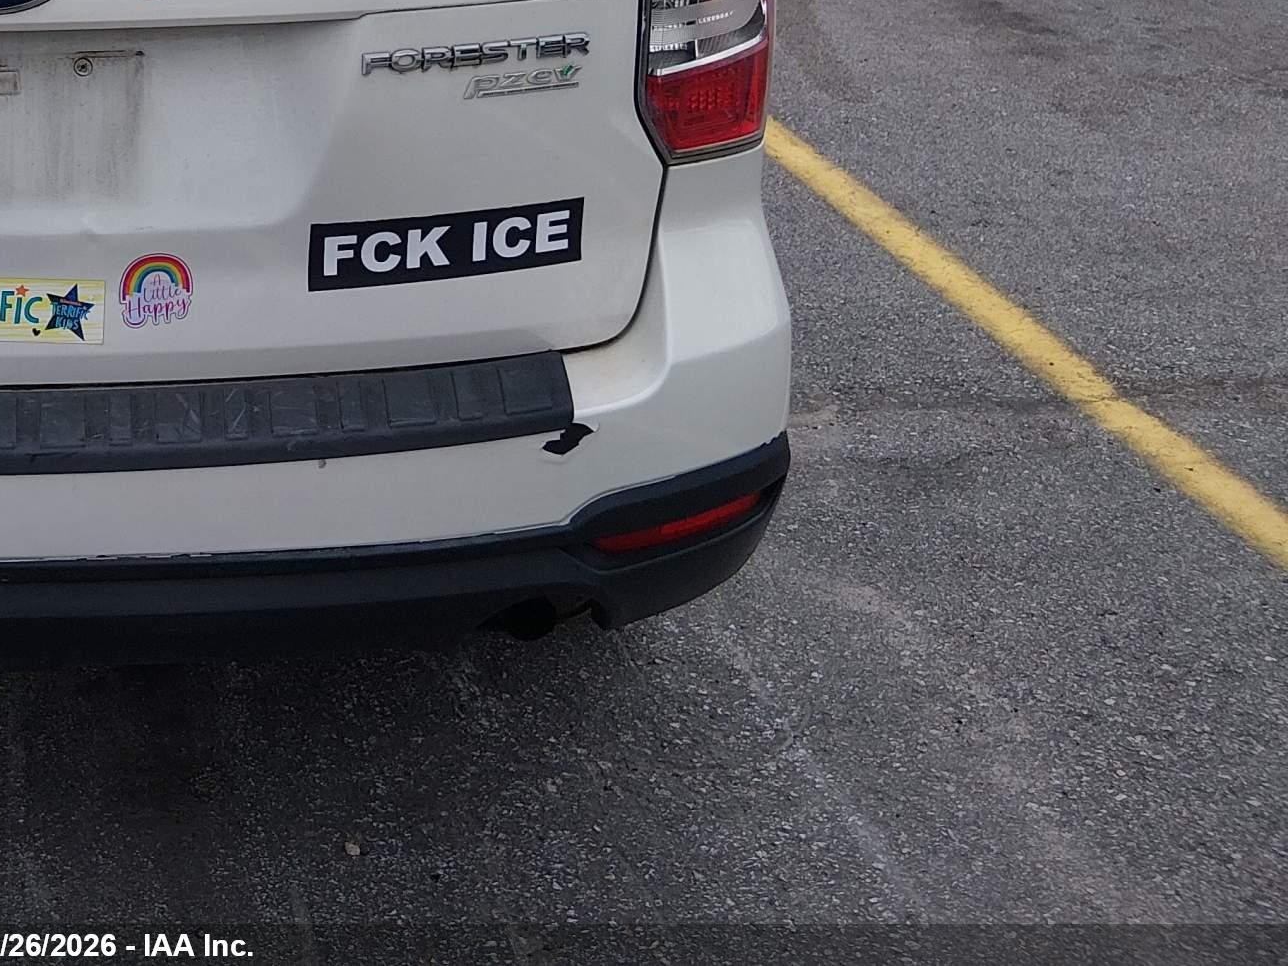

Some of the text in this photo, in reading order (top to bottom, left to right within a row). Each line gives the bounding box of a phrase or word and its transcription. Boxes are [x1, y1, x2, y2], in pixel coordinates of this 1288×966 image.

[362, 32, 590, 76] FORESTER
[323, 210, 571, 277] FCK ICE
[127, 297, 188, 324] Happy
